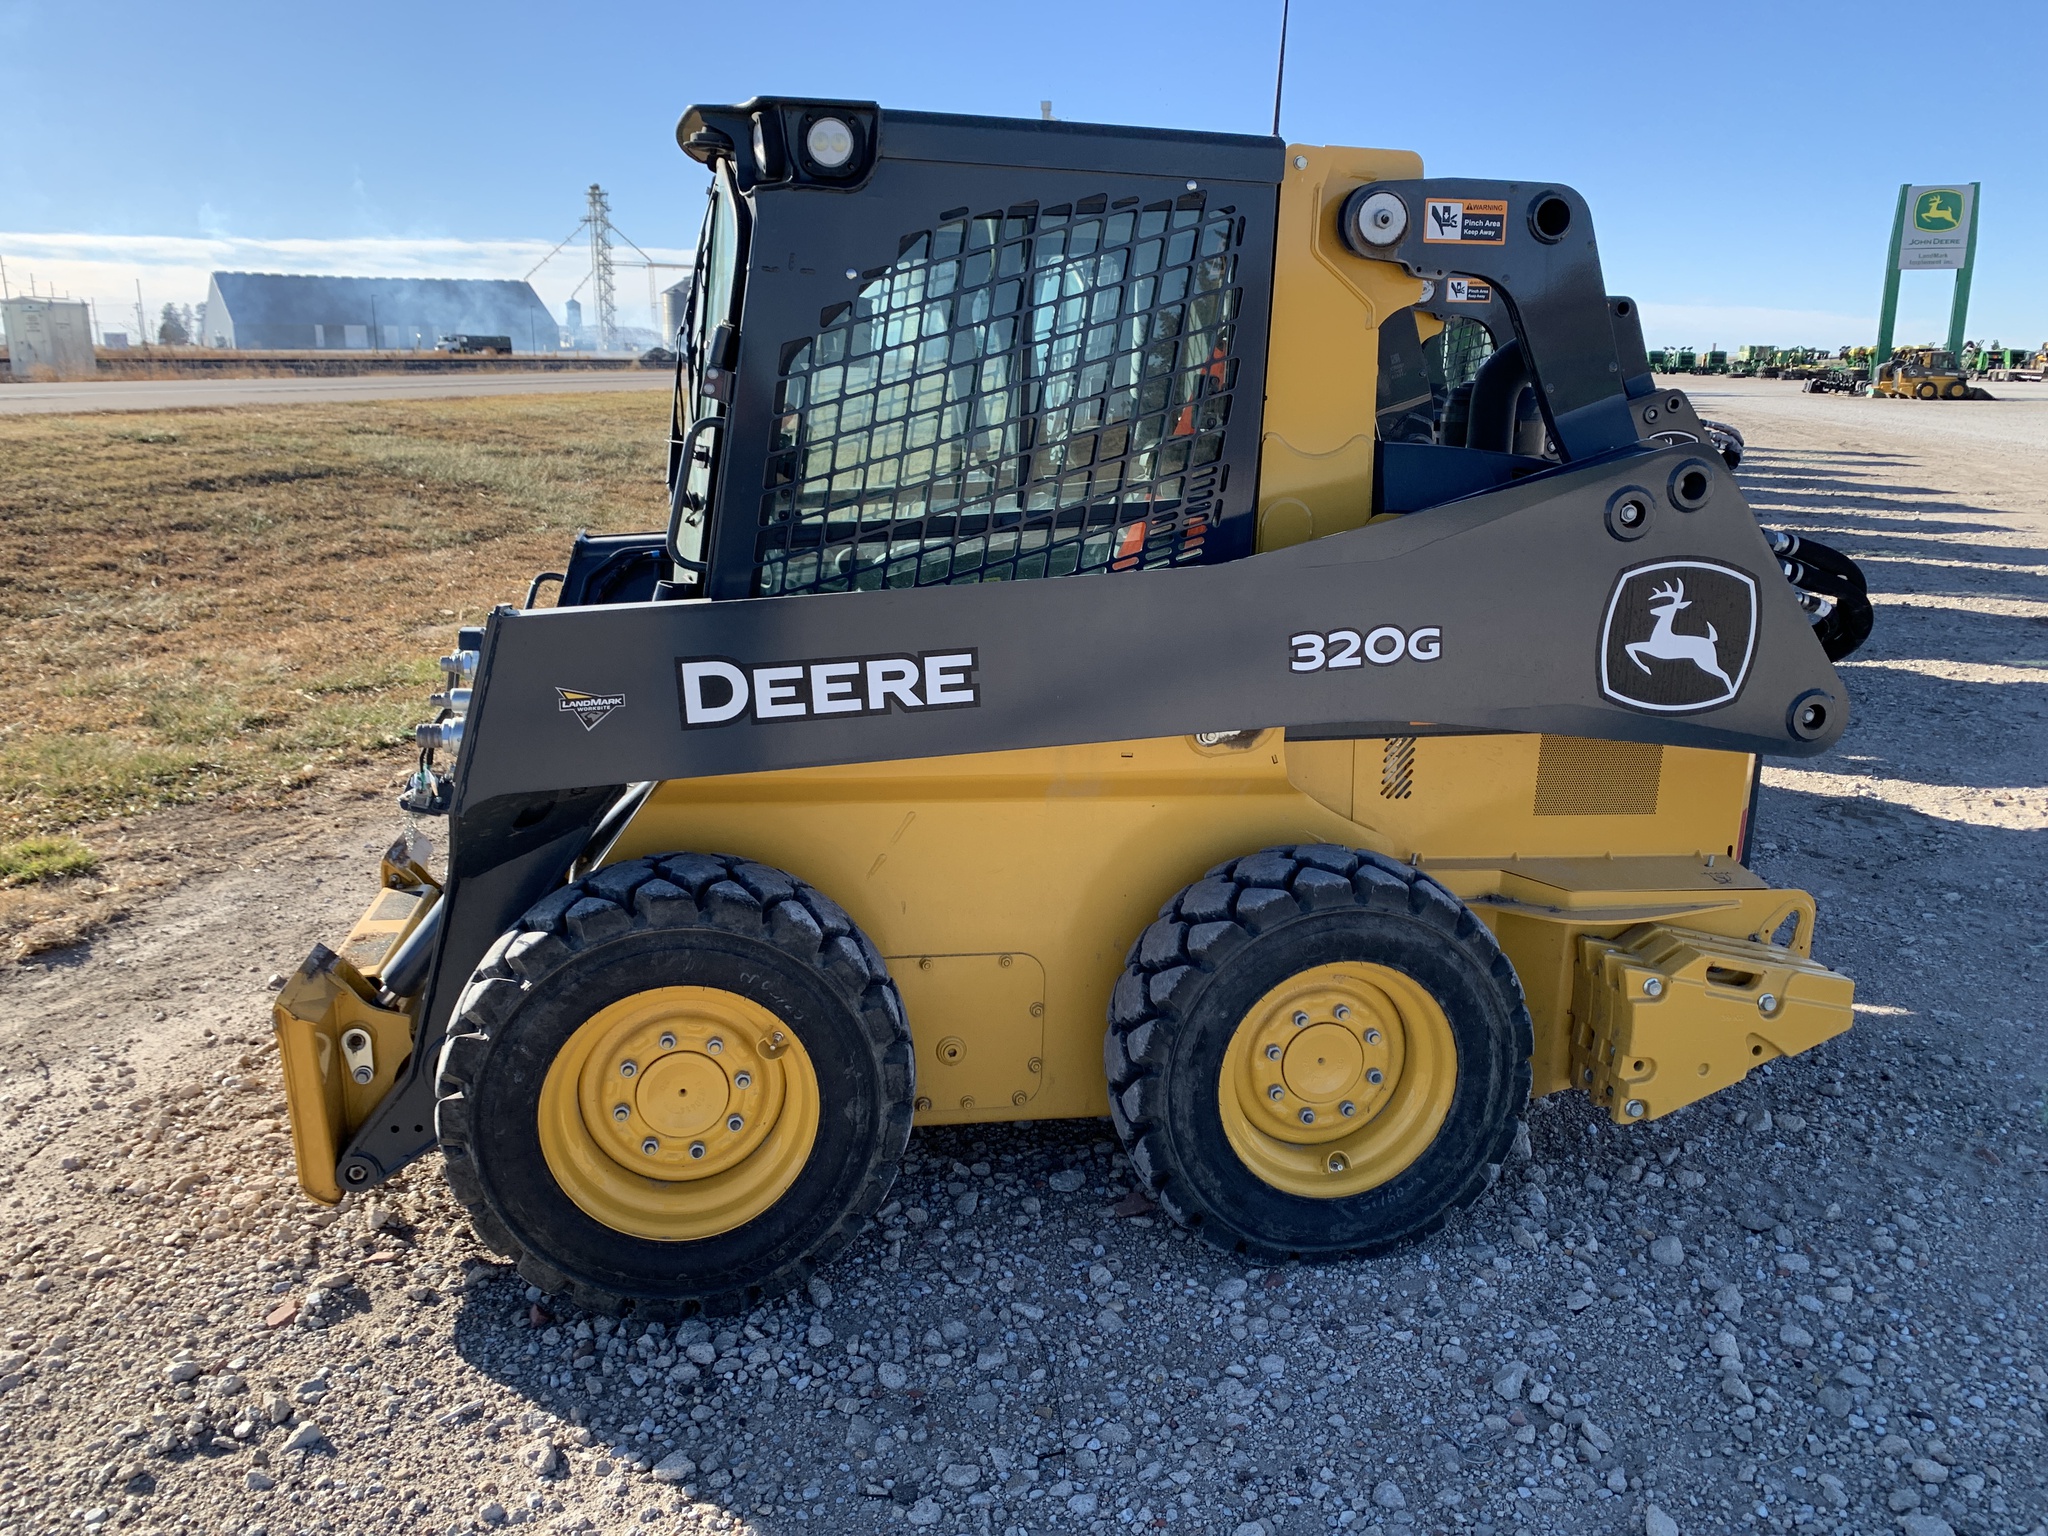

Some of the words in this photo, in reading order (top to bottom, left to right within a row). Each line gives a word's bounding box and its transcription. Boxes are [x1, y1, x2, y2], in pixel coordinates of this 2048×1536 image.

[1464, 219, 1484, 227] Pinch
[1291, 626, 1441, 671] 320G
[681, 653, 975, 724] DEERE
